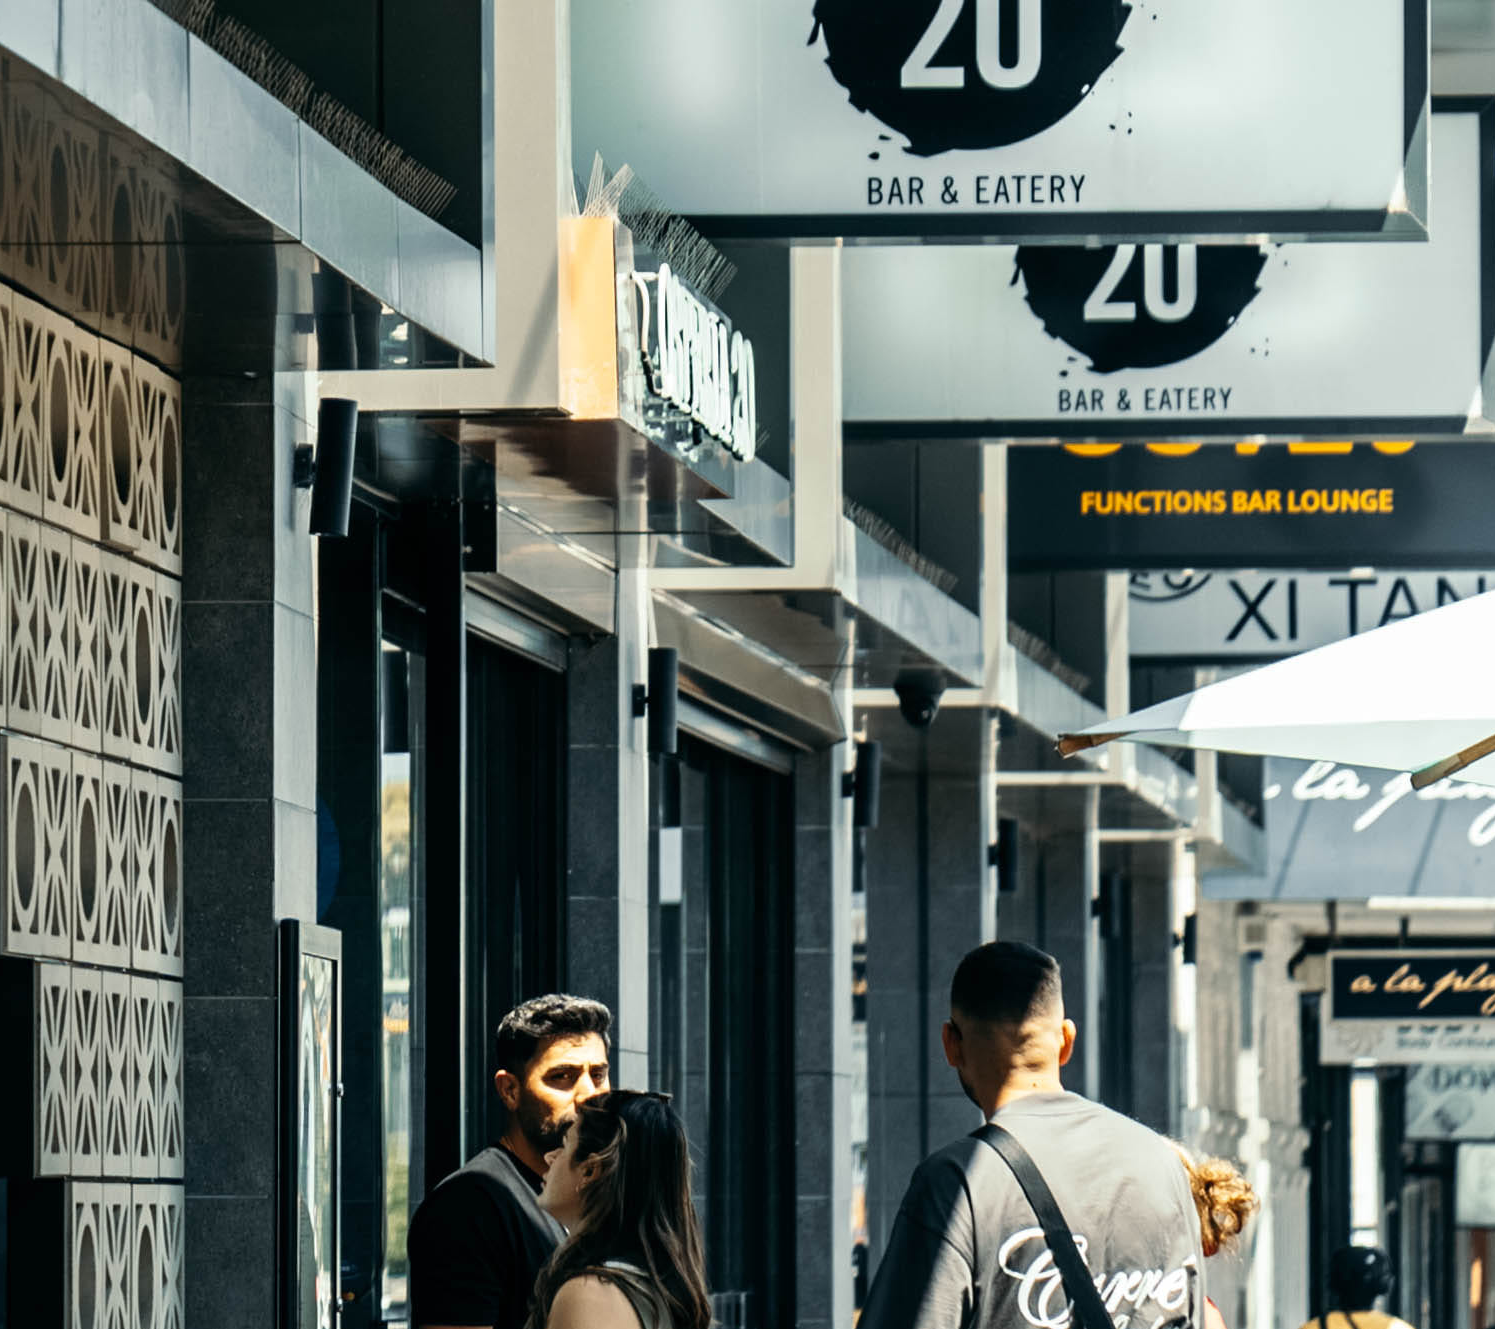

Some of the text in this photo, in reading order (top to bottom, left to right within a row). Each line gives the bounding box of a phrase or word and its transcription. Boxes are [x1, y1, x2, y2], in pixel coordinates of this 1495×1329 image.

[867, 174, 1086, 205] BAR & EATERY
[1083, 243, 1198, 322] 20
[1058, 386, 1233, 413] BAR & EATERY
[1081, 489, 1393, 514] FUNCTIONS BAR LOUNGE
[1226, 579, 1298, 641] XI
[1351, 974, 1376, 993] a
[1383, 964, 1426, 993] la
